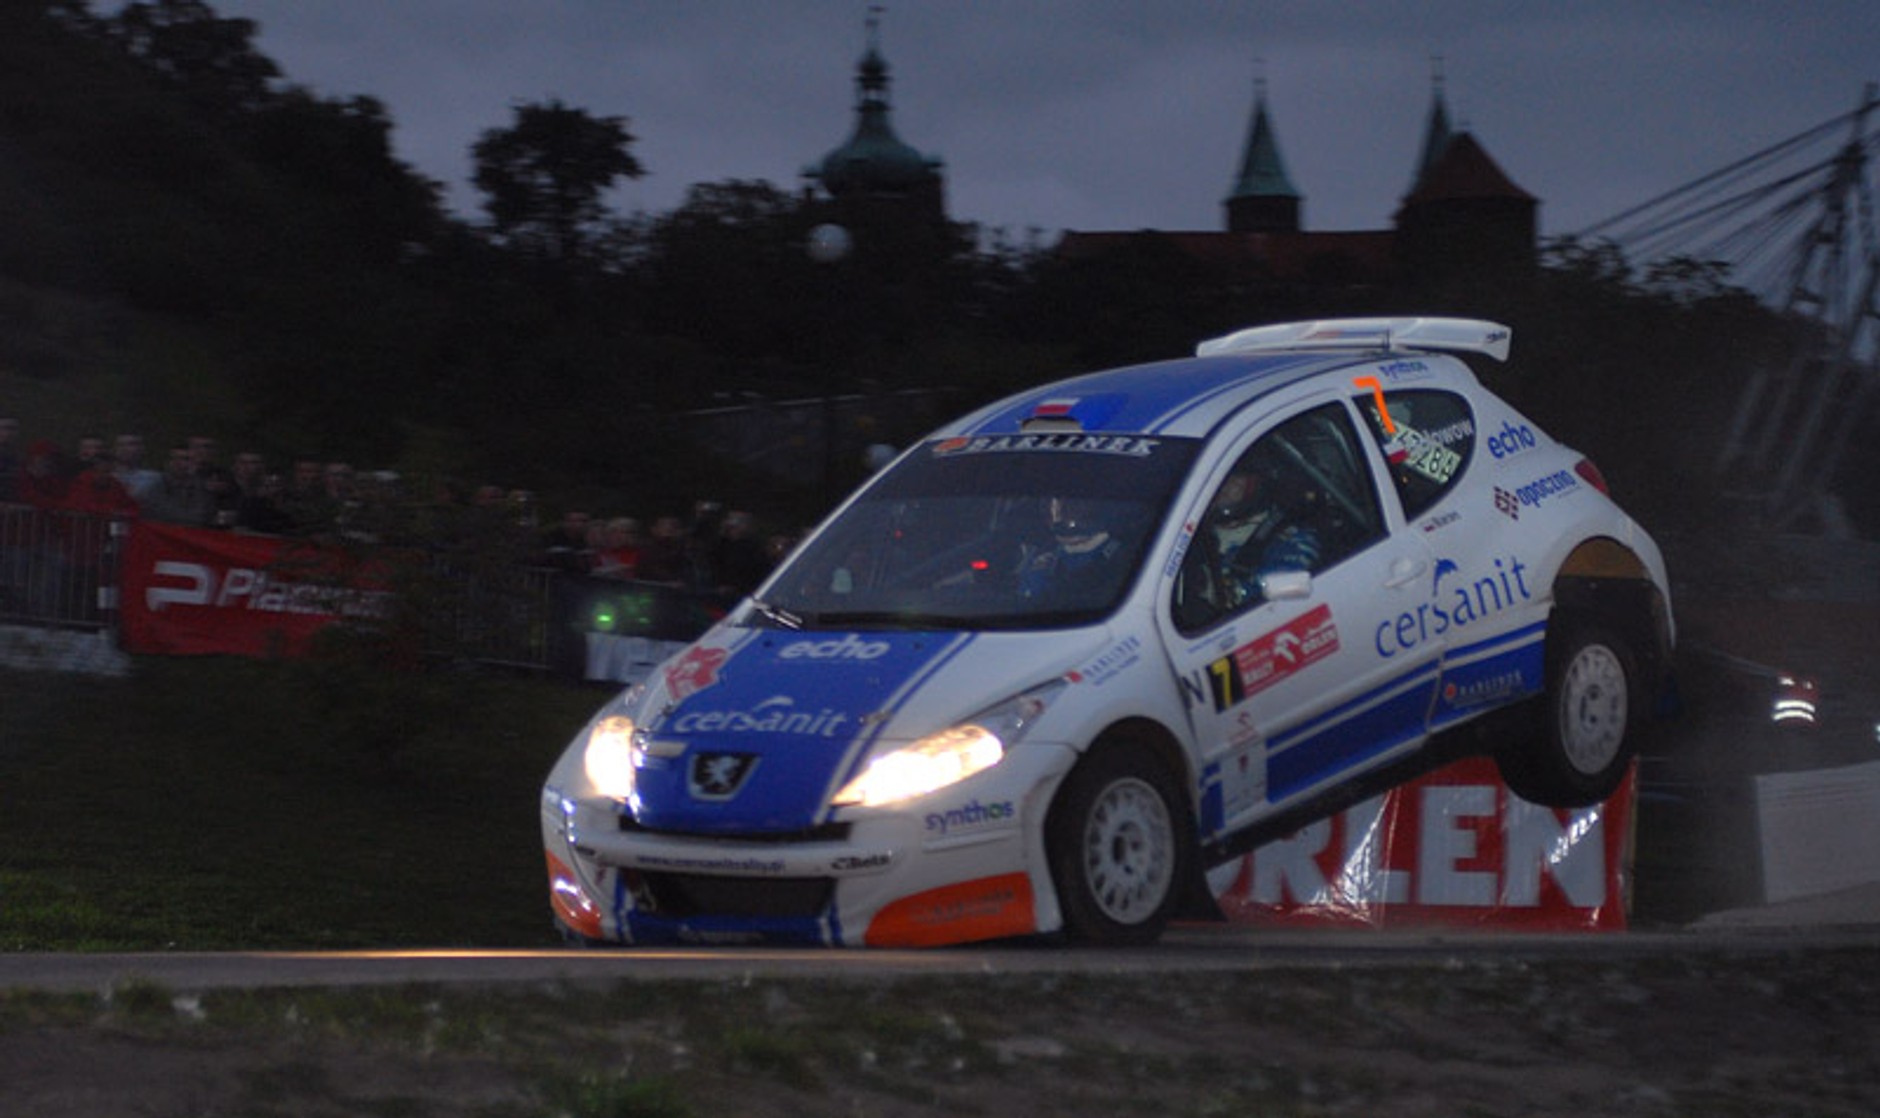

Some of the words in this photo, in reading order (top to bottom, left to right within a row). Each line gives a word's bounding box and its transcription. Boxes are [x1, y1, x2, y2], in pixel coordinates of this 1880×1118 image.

[1353, 376, 1396, 434] 7
[966, 435, 1160, 455] BARLINEK
[1488, 420, 1536, 459] echo
[1516, 470, 1577, 508] opoczno
[1376, 556, 1531, 658] cersanit
[778, 632, 891, 660] echo
[1210, 656, 1233, 709] 7
[672, 703, 848, 738] cersanit
[924, 799, 1014, 833] synthos
